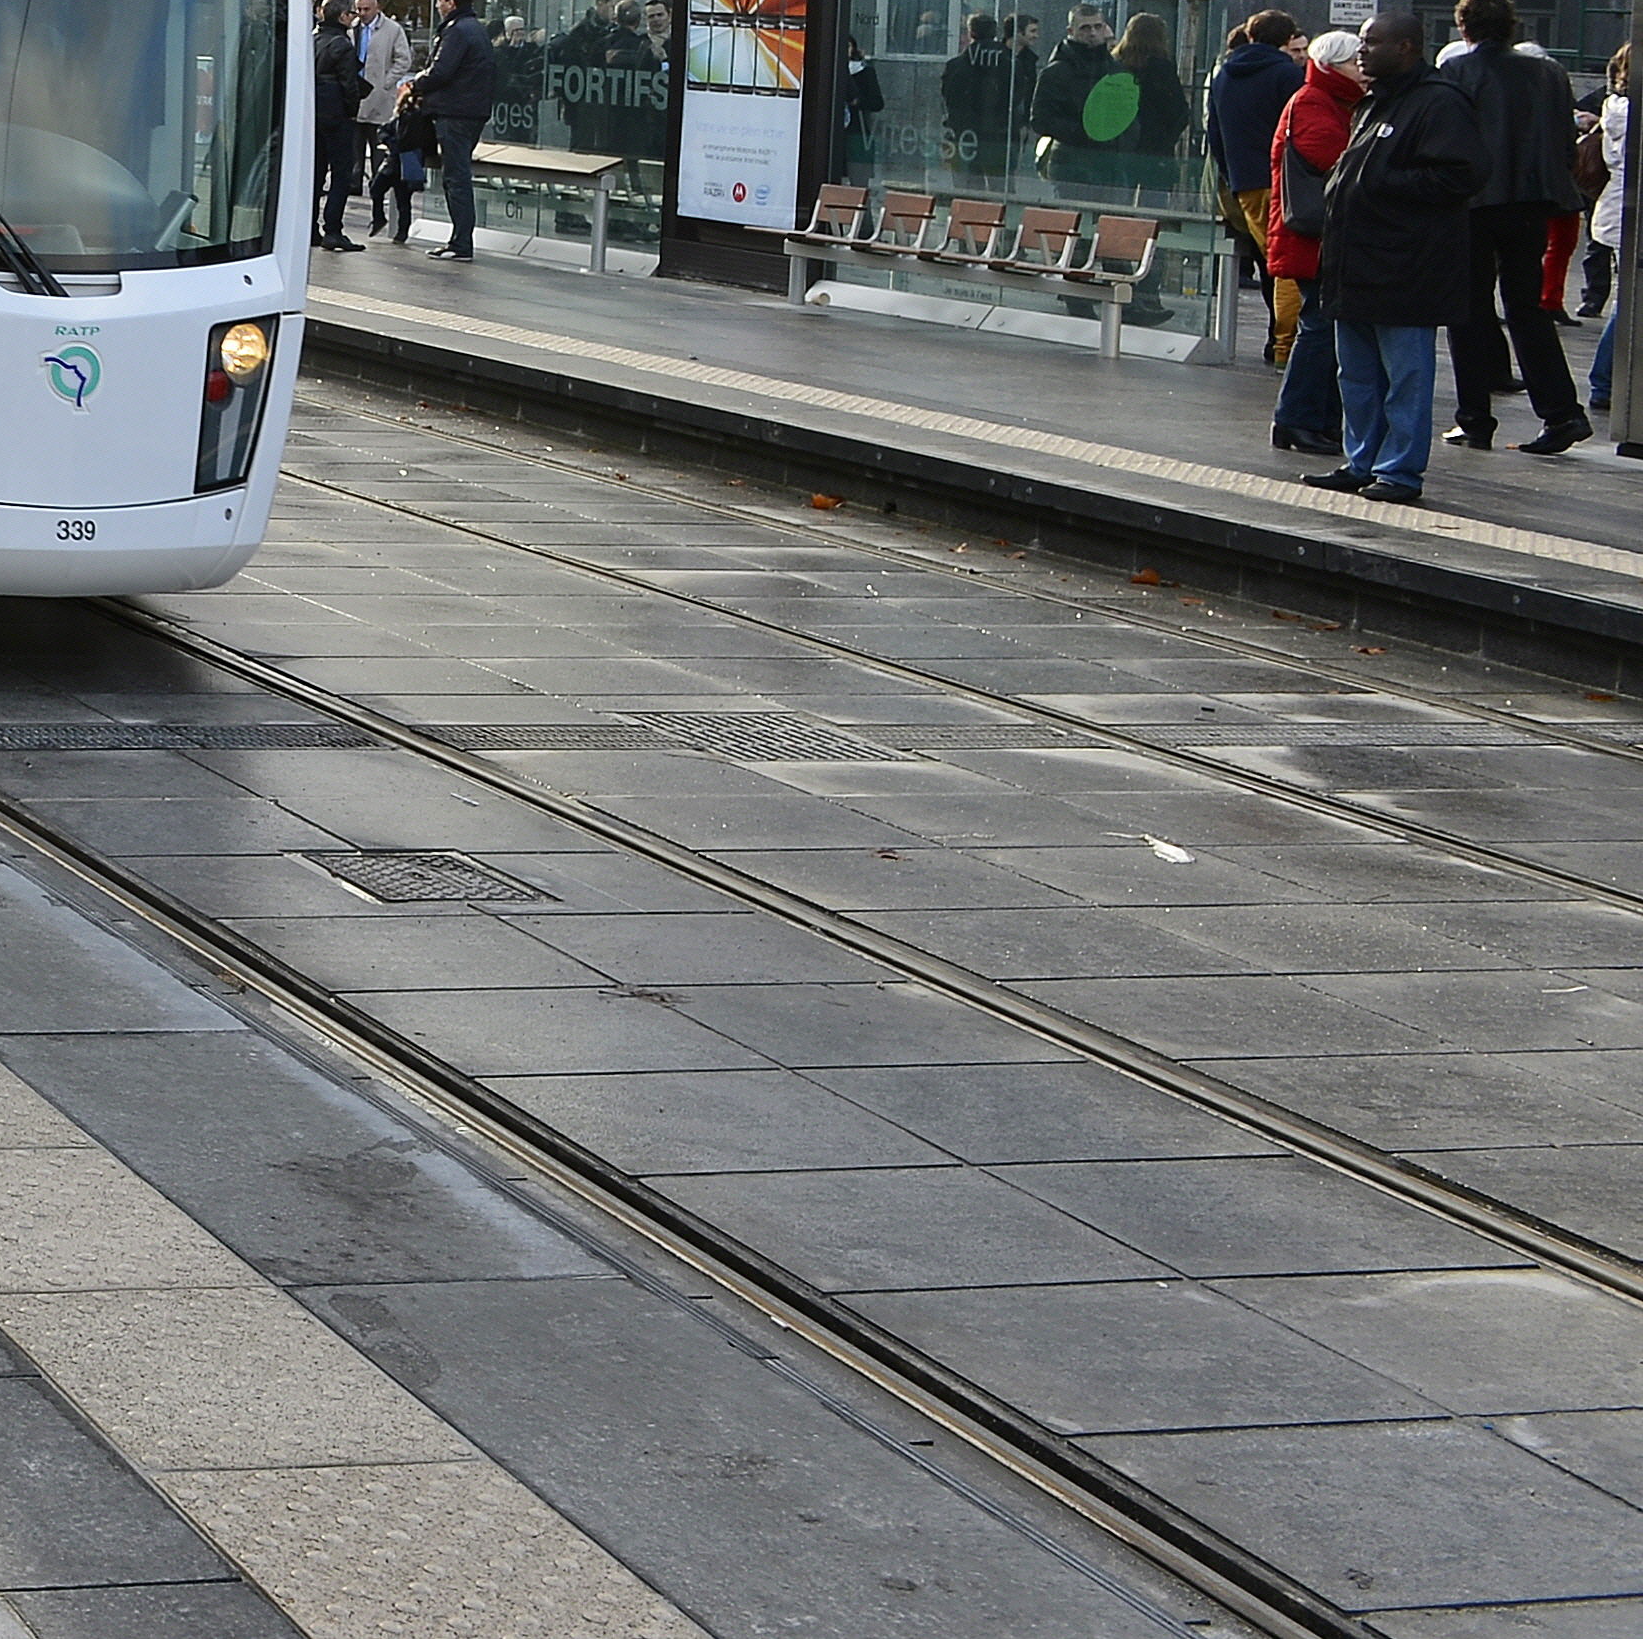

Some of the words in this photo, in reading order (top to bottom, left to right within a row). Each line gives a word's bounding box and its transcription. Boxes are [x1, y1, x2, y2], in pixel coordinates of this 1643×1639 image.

[967, 43, 1003, 67] Vrrr
[547, 63, 669, 112] FORTIFS
[55, 325, 100, 336] RATP
[56, 519, 96, 542] 339
